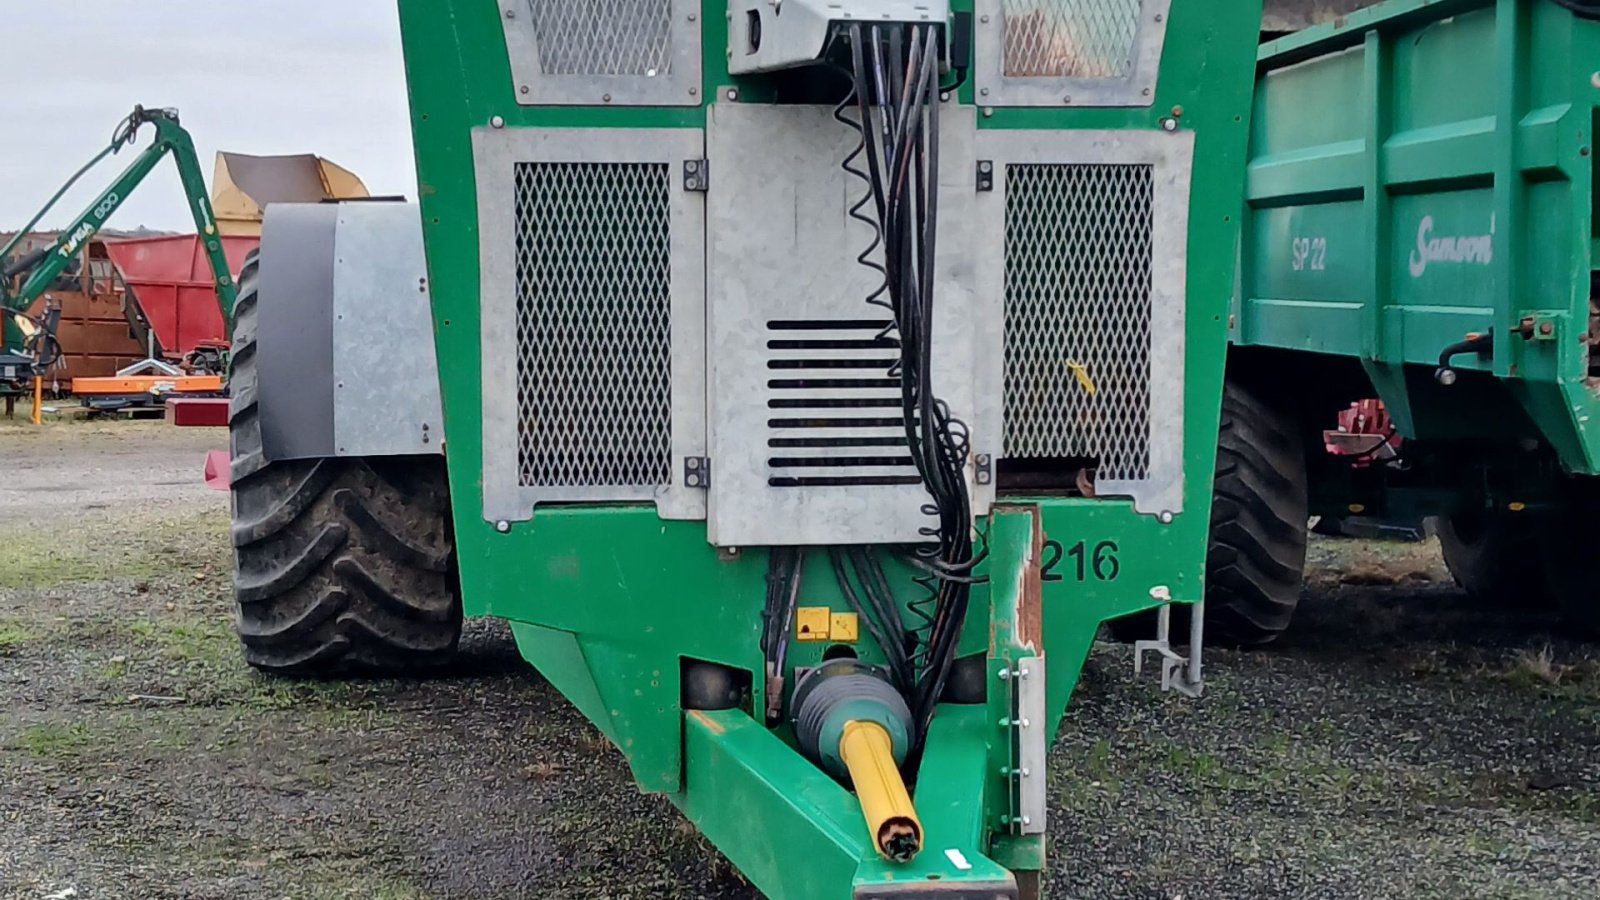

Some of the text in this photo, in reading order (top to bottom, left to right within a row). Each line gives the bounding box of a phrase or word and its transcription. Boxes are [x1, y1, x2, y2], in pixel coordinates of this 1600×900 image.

[1292, 237, 1327, 271] SP 22
[1409, 215, 1493, 277] Samson
[1040, 540, 1119, 581] 216
